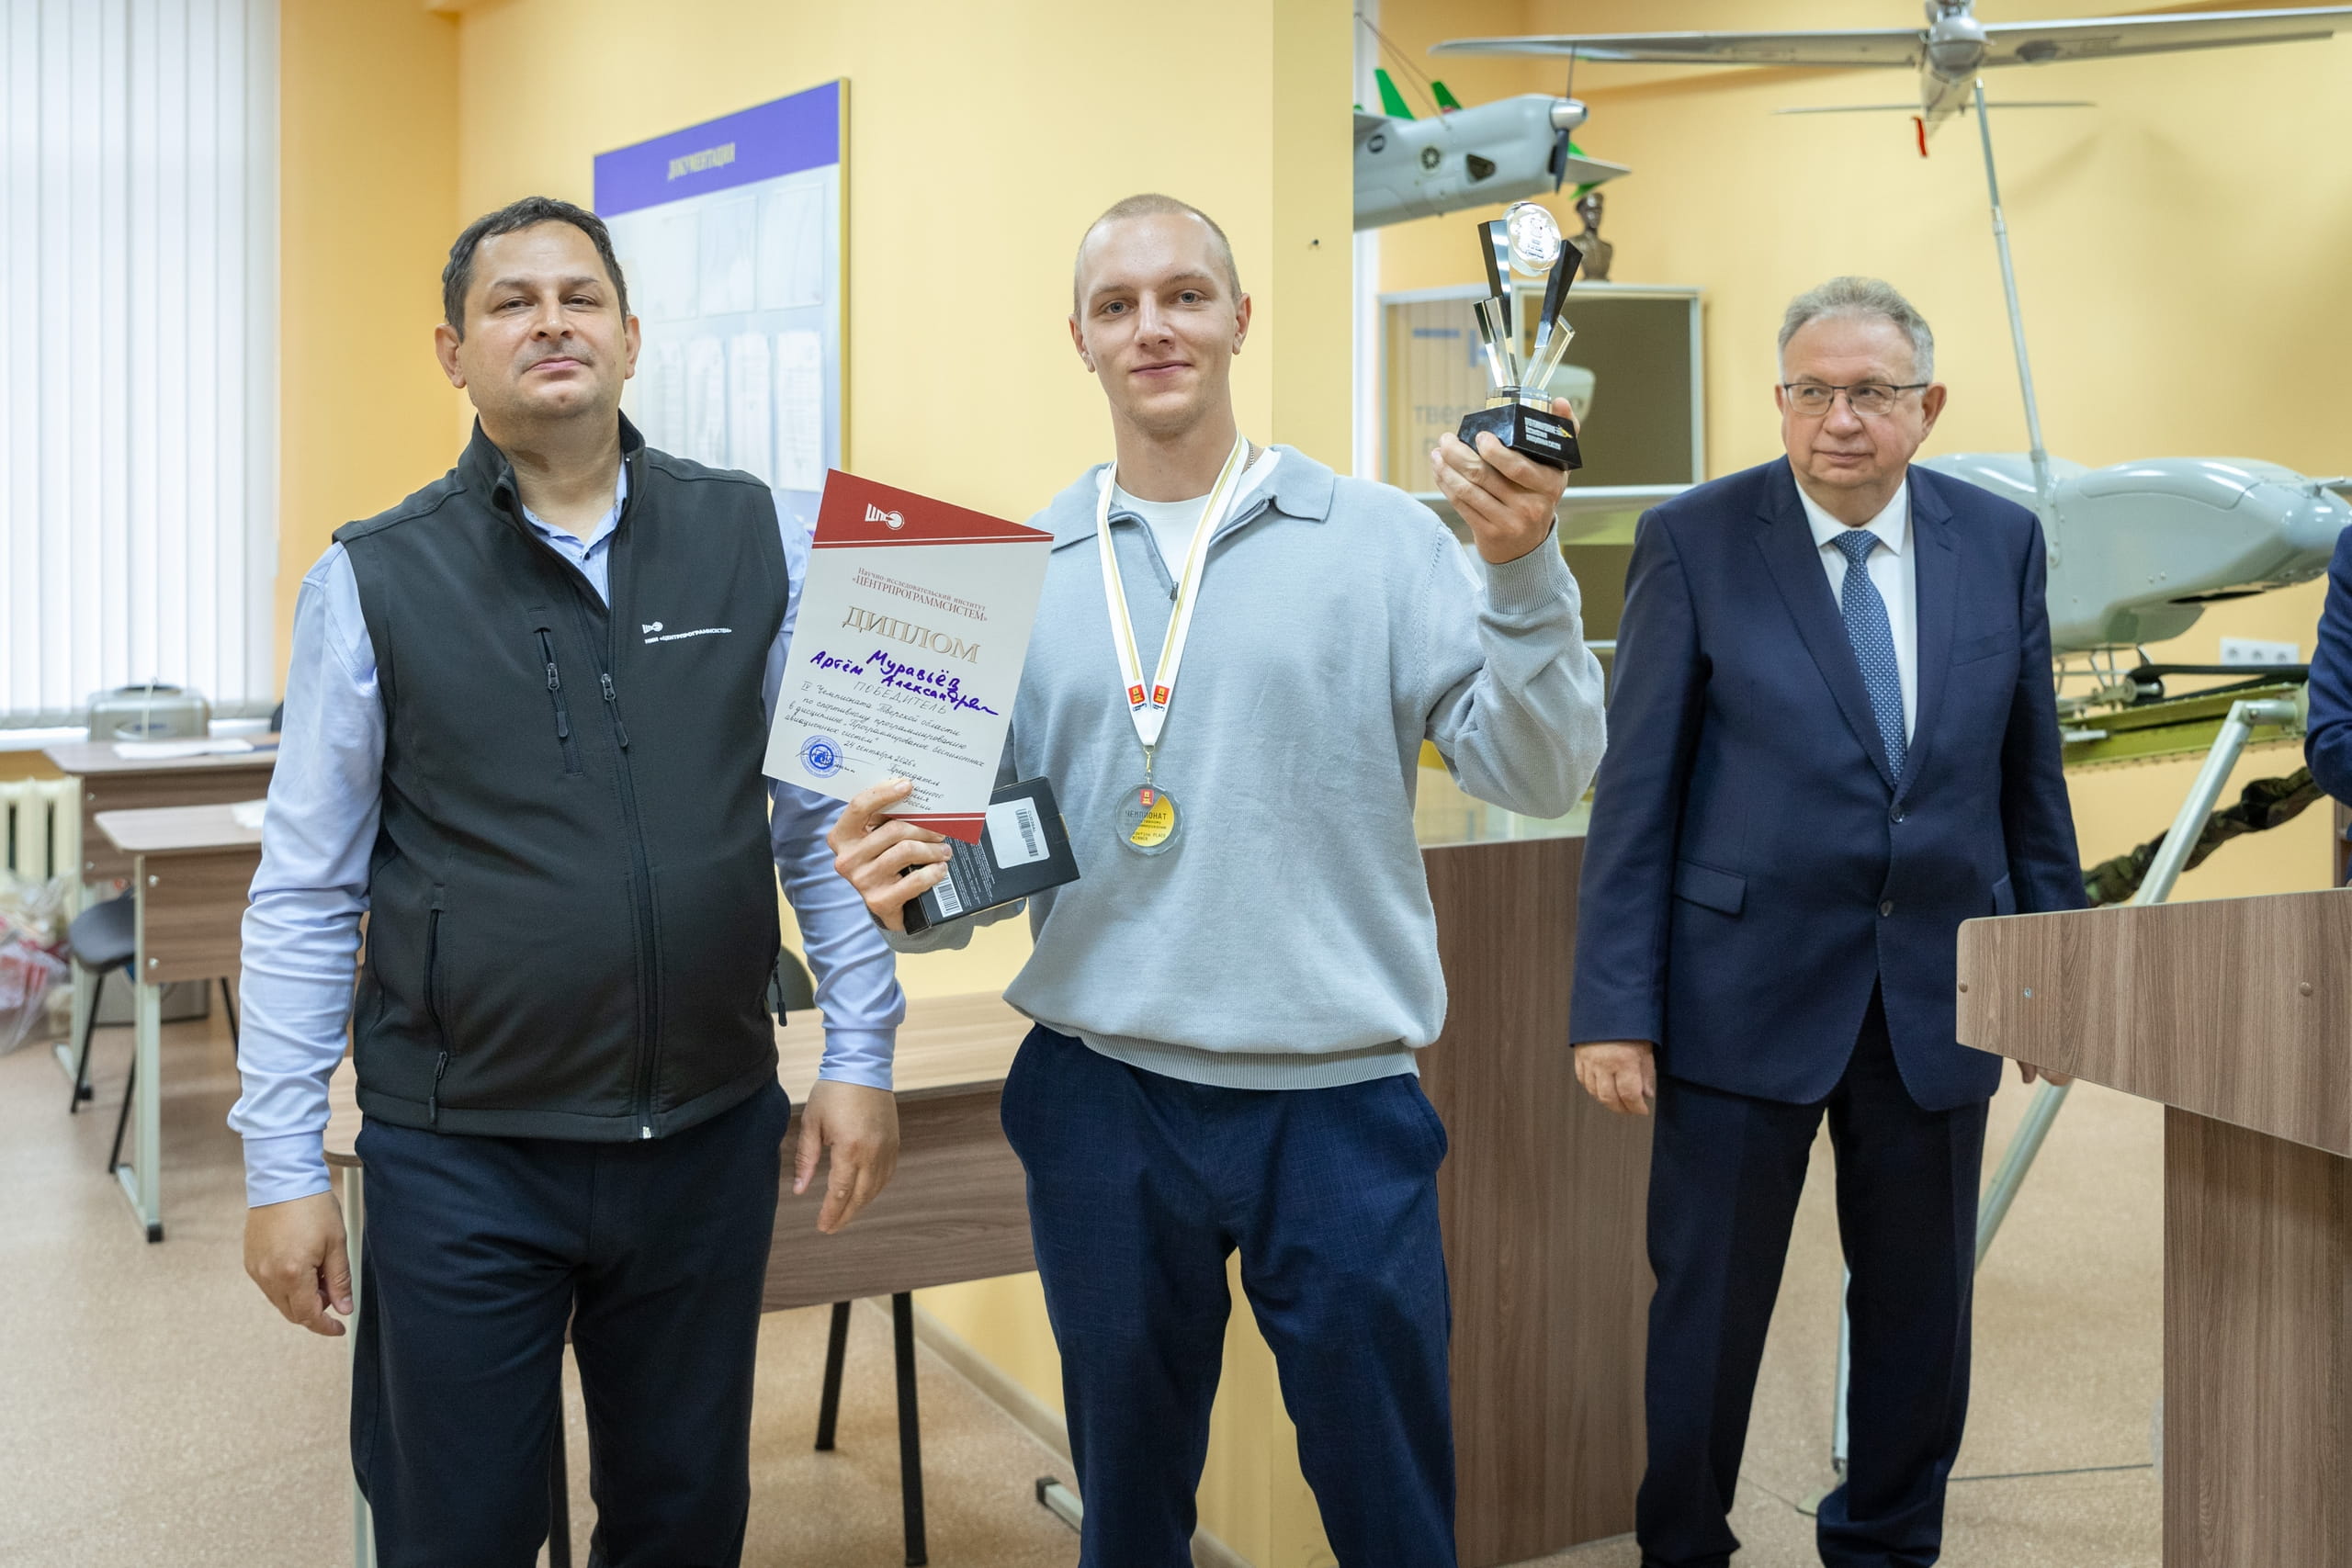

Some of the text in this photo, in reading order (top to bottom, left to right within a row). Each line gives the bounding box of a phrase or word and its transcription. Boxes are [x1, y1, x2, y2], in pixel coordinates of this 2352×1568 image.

[853, 575, 988, 621] «ЦЕНТРПРОГРАММСИСТЕМ»
[858, 567, 986, 612] Научно-исследовательский институт
[842, 606, 981, 664] ДИПЛОМ
[809, 650, 864, 676] Артём
[794, 706, 842, 724] дисциплине
[817, 684, 872, 708] Чемпионата
[876, 703, 920, 723] Тверской
[921, 719, 961, 737] области
[854, 681, 947, 715] ПОБЕДИТЕЛЬ
[785, 715, 839, 733] авиационных
[816, 701, 871, 724] спортивному
[874, 718, 967, 750] программированию
[843, 740, 855, 749] 24
[855, 745, 893, 761] сентября
